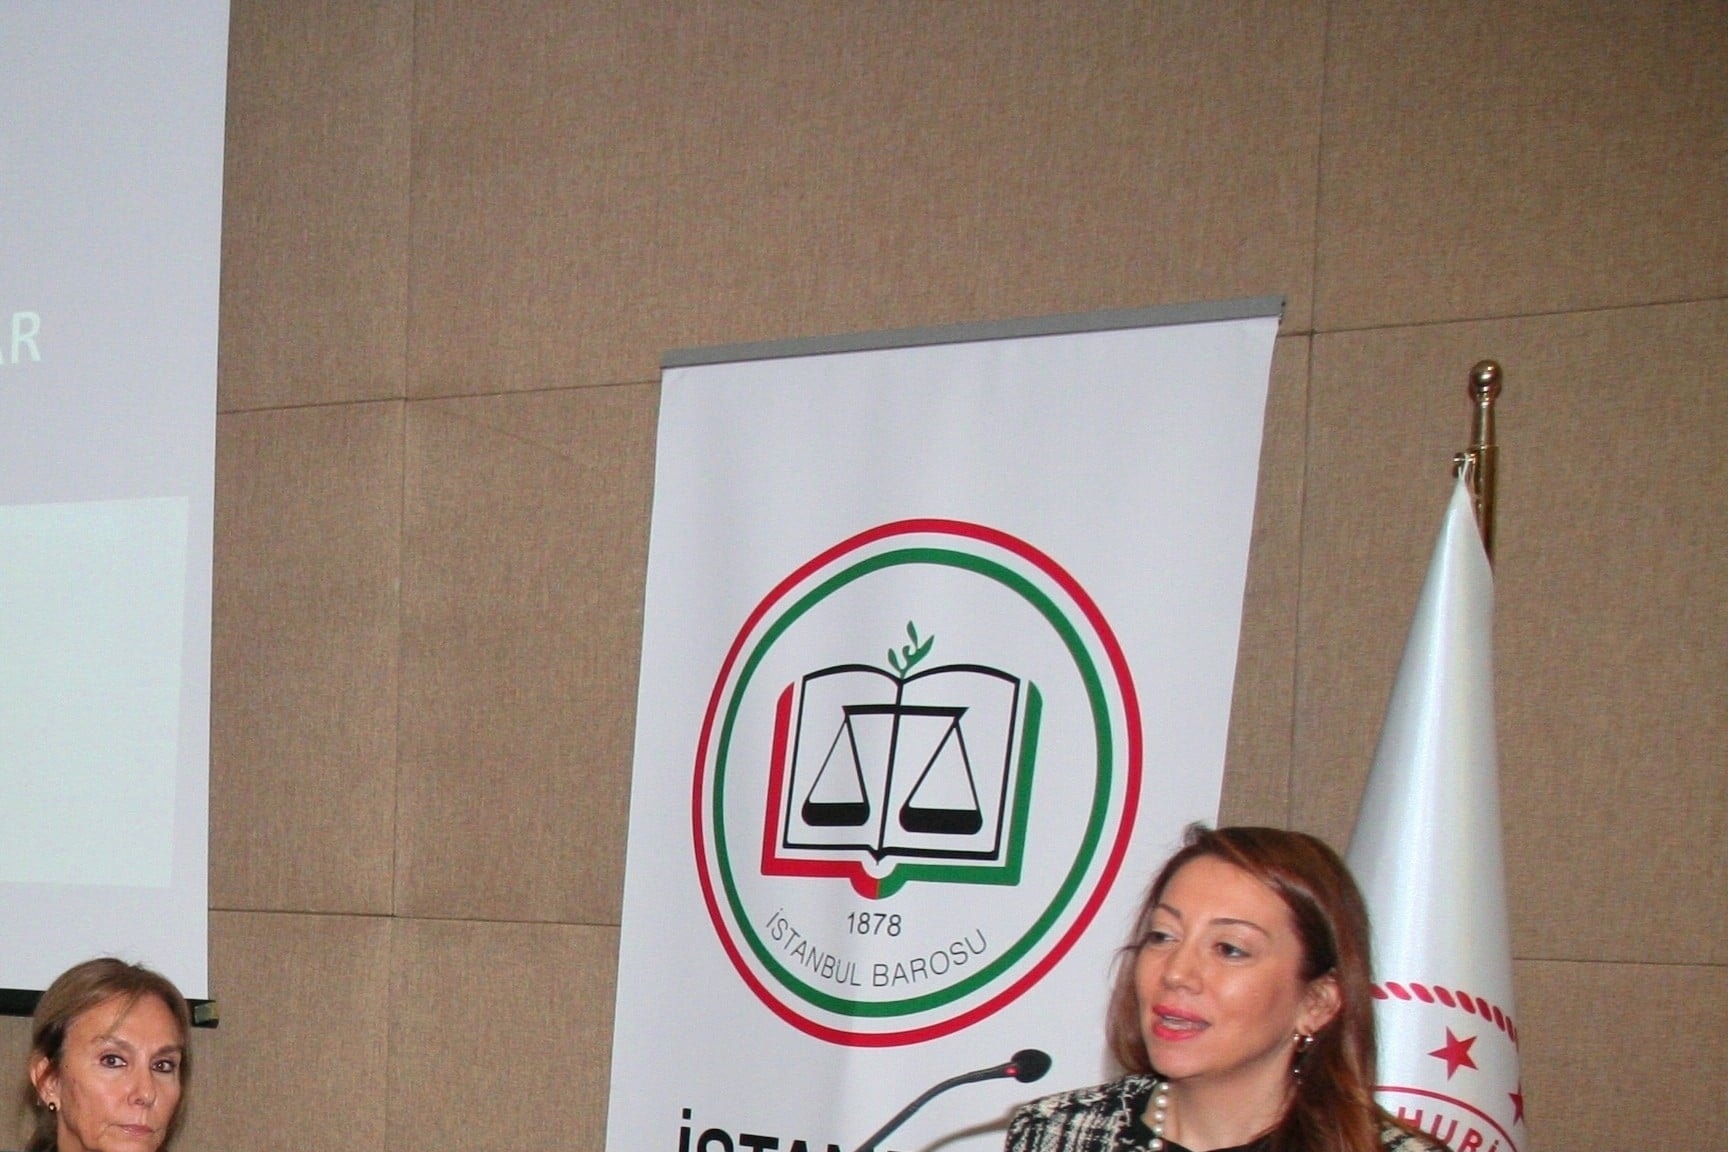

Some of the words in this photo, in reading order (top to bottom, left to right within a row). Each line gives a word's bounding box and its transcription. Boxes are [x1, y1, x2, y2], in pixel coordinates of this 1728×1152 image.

[765, 907, 863, 987] İSTANBUL
[872, 928, 988, 988] BAROSU
[846, 911, 903, 937] 1878
